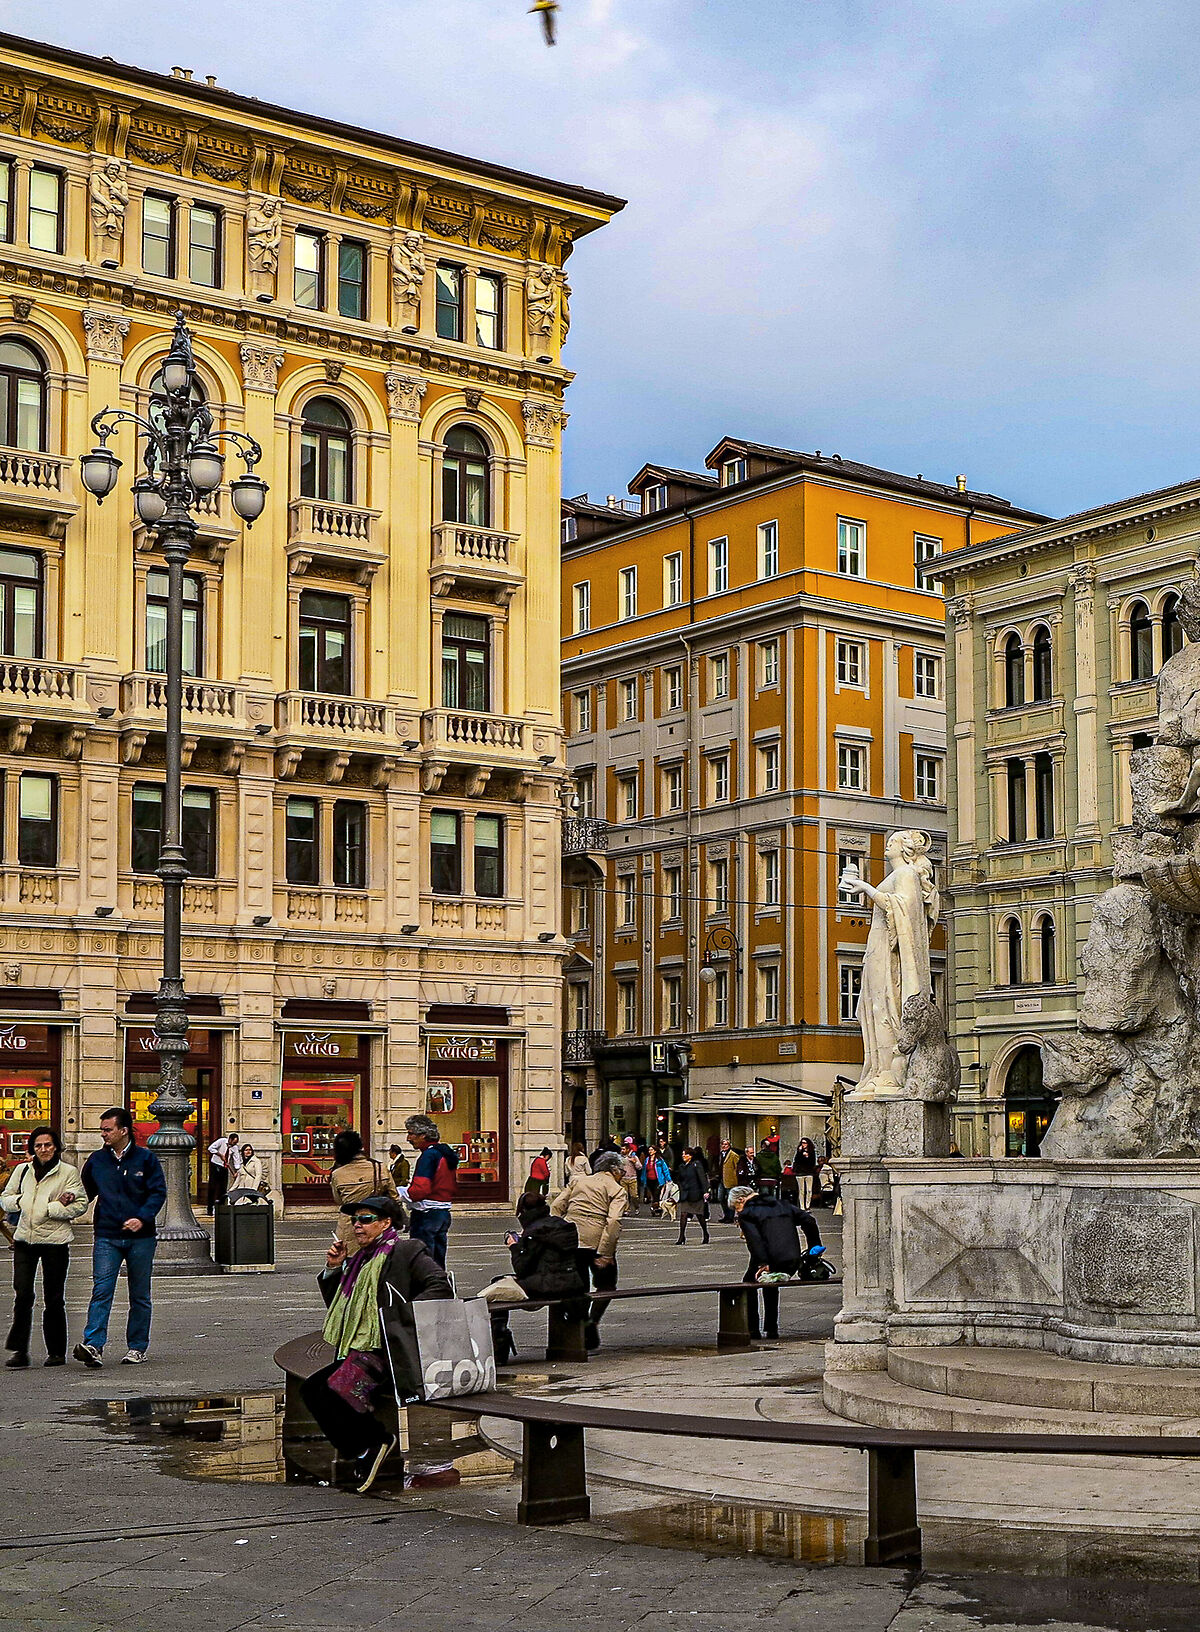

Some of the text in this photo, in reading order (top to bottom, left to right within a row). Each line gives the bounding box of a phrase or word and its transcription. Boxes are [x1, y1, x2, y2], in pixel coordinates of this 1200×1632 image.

[0, 1036, 28, 1049] ND
[293, 1042, 340, 1056] WIND
[436, 1046, 479, 1059] WIND
